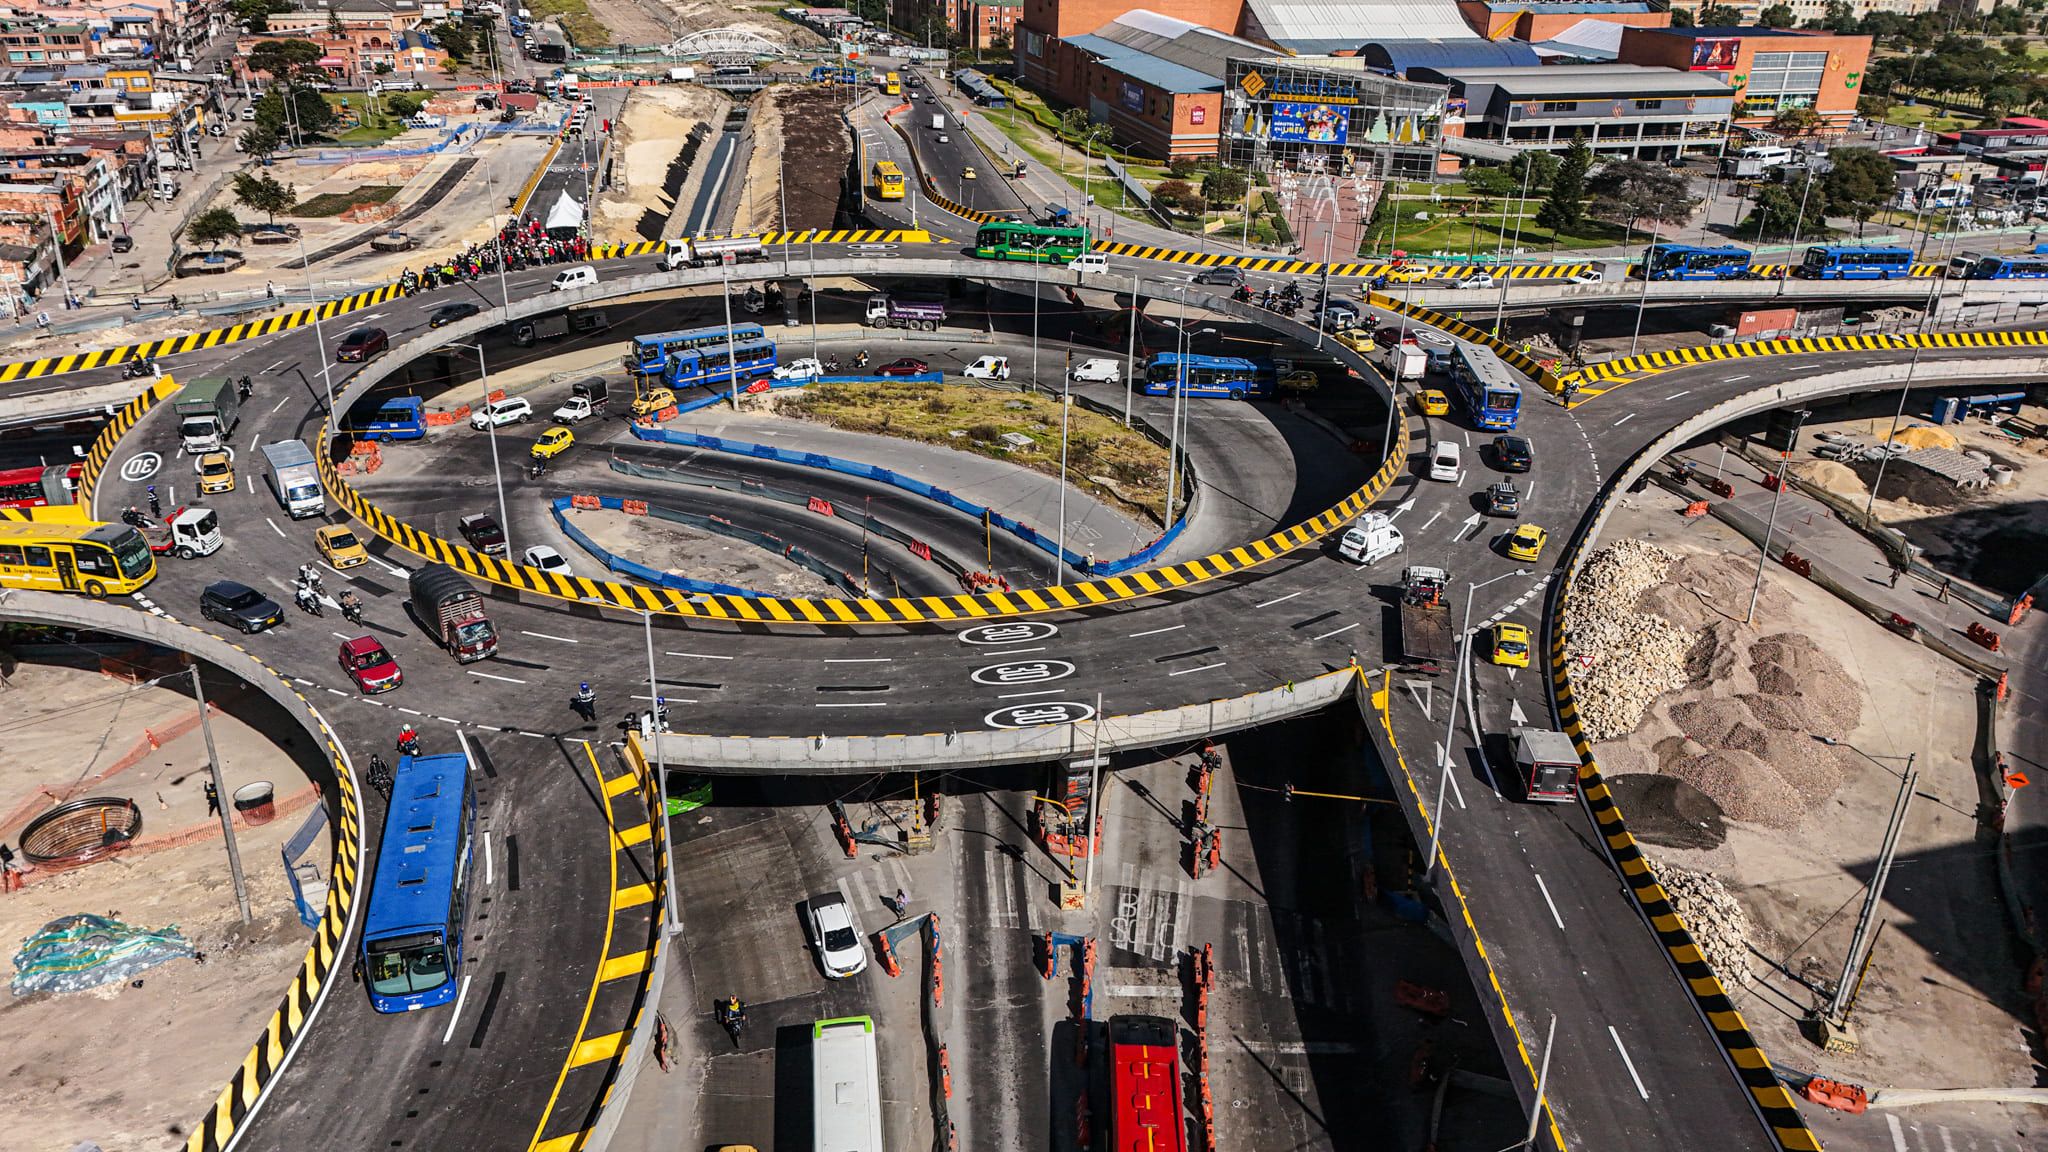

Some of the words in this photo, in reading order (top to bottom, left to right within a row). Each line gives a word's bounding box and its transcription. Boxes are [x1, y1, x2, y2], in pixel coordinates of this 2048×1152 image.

[127, 457, 156, 475] 30
[981, 625, 1034, 641] 30
[996, 663, 1051, 681] 30
[1011, 706, 1069, 725] 30
